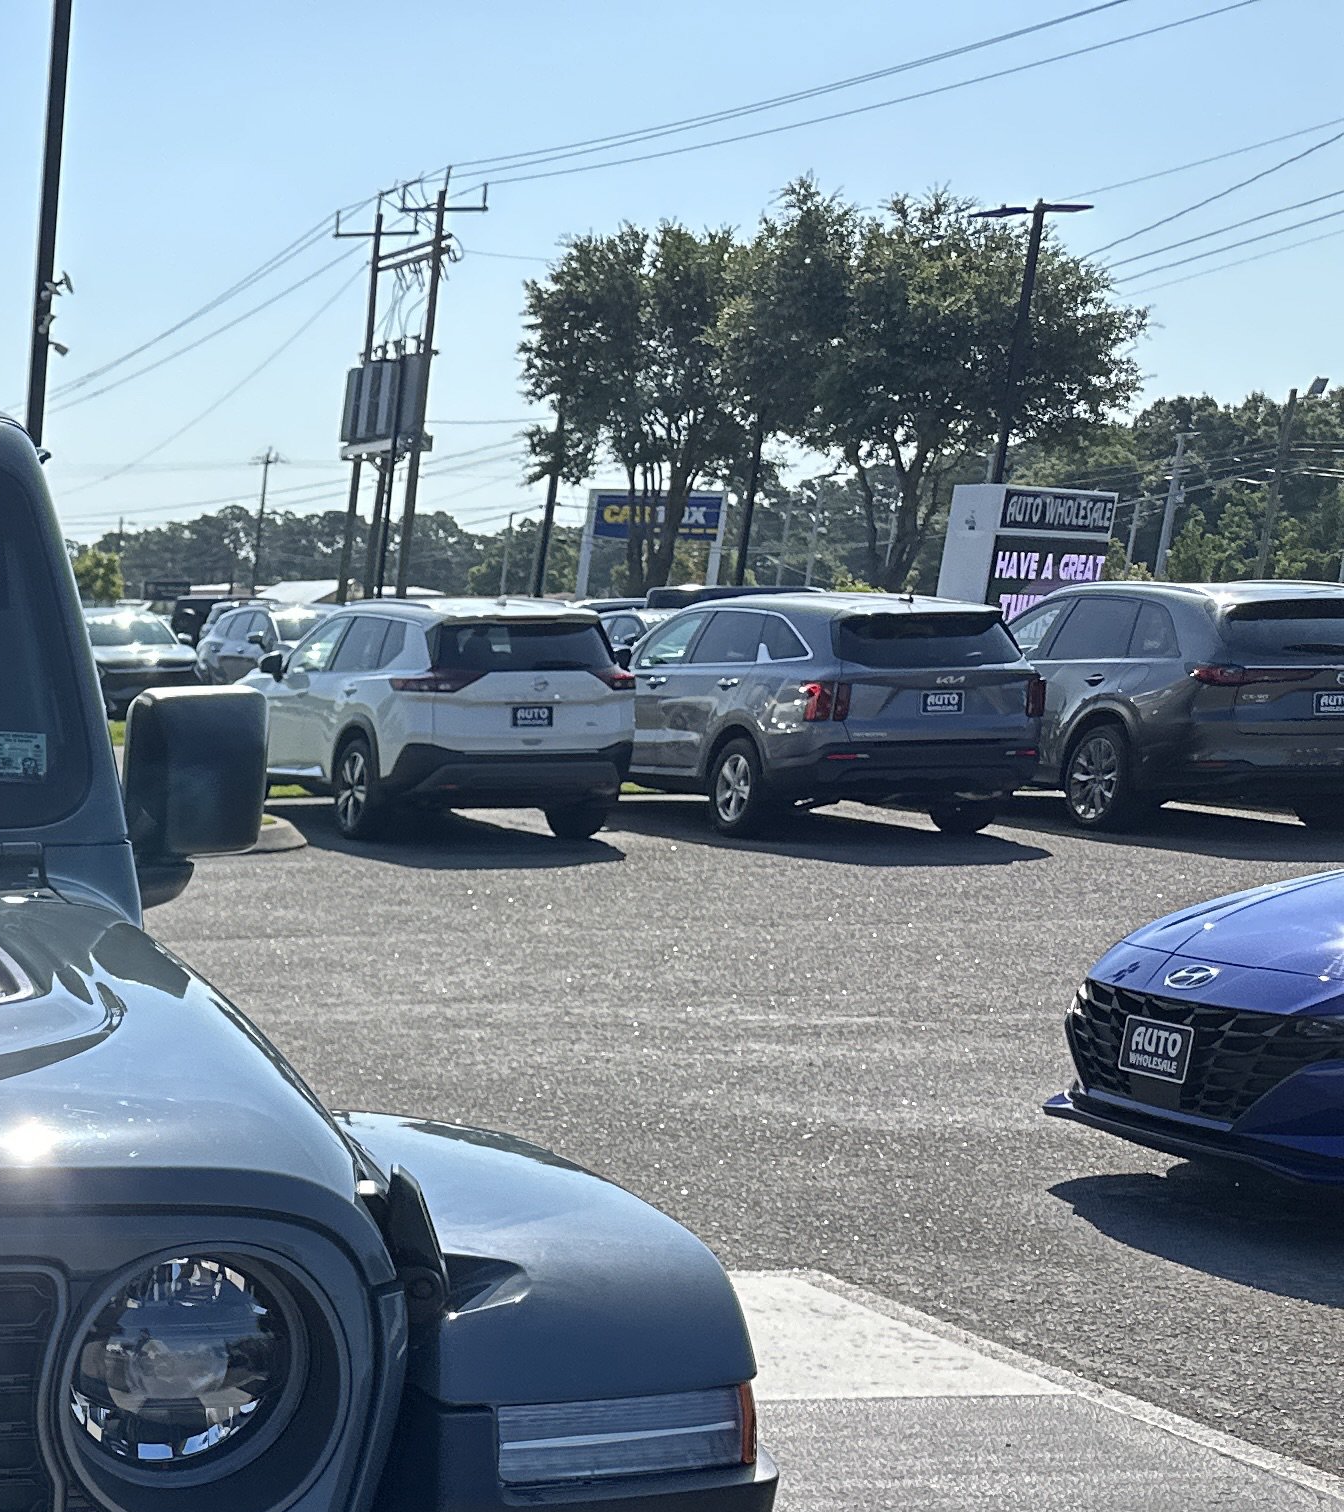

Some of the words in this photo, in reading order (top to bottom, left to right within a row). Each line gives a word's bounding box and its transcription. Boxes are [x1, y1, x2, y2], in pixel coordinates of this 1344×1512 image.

[1006, 496, 1043, 524] AUTO
[1044, 496, 1113, 528] WHOLESALE
[994, 551, 1040, 580] HAVE
[1040, 553, 1054, 580] A
[1058, 554, 1106, 581] GREAT
[926, 693, 959, 705] AUTO
[517, 708, 549, 719] AUTO
[1131, 1025, 1182, 1058] AUTO
[1128, 1051, 1178, 1074] WHOLESALE
